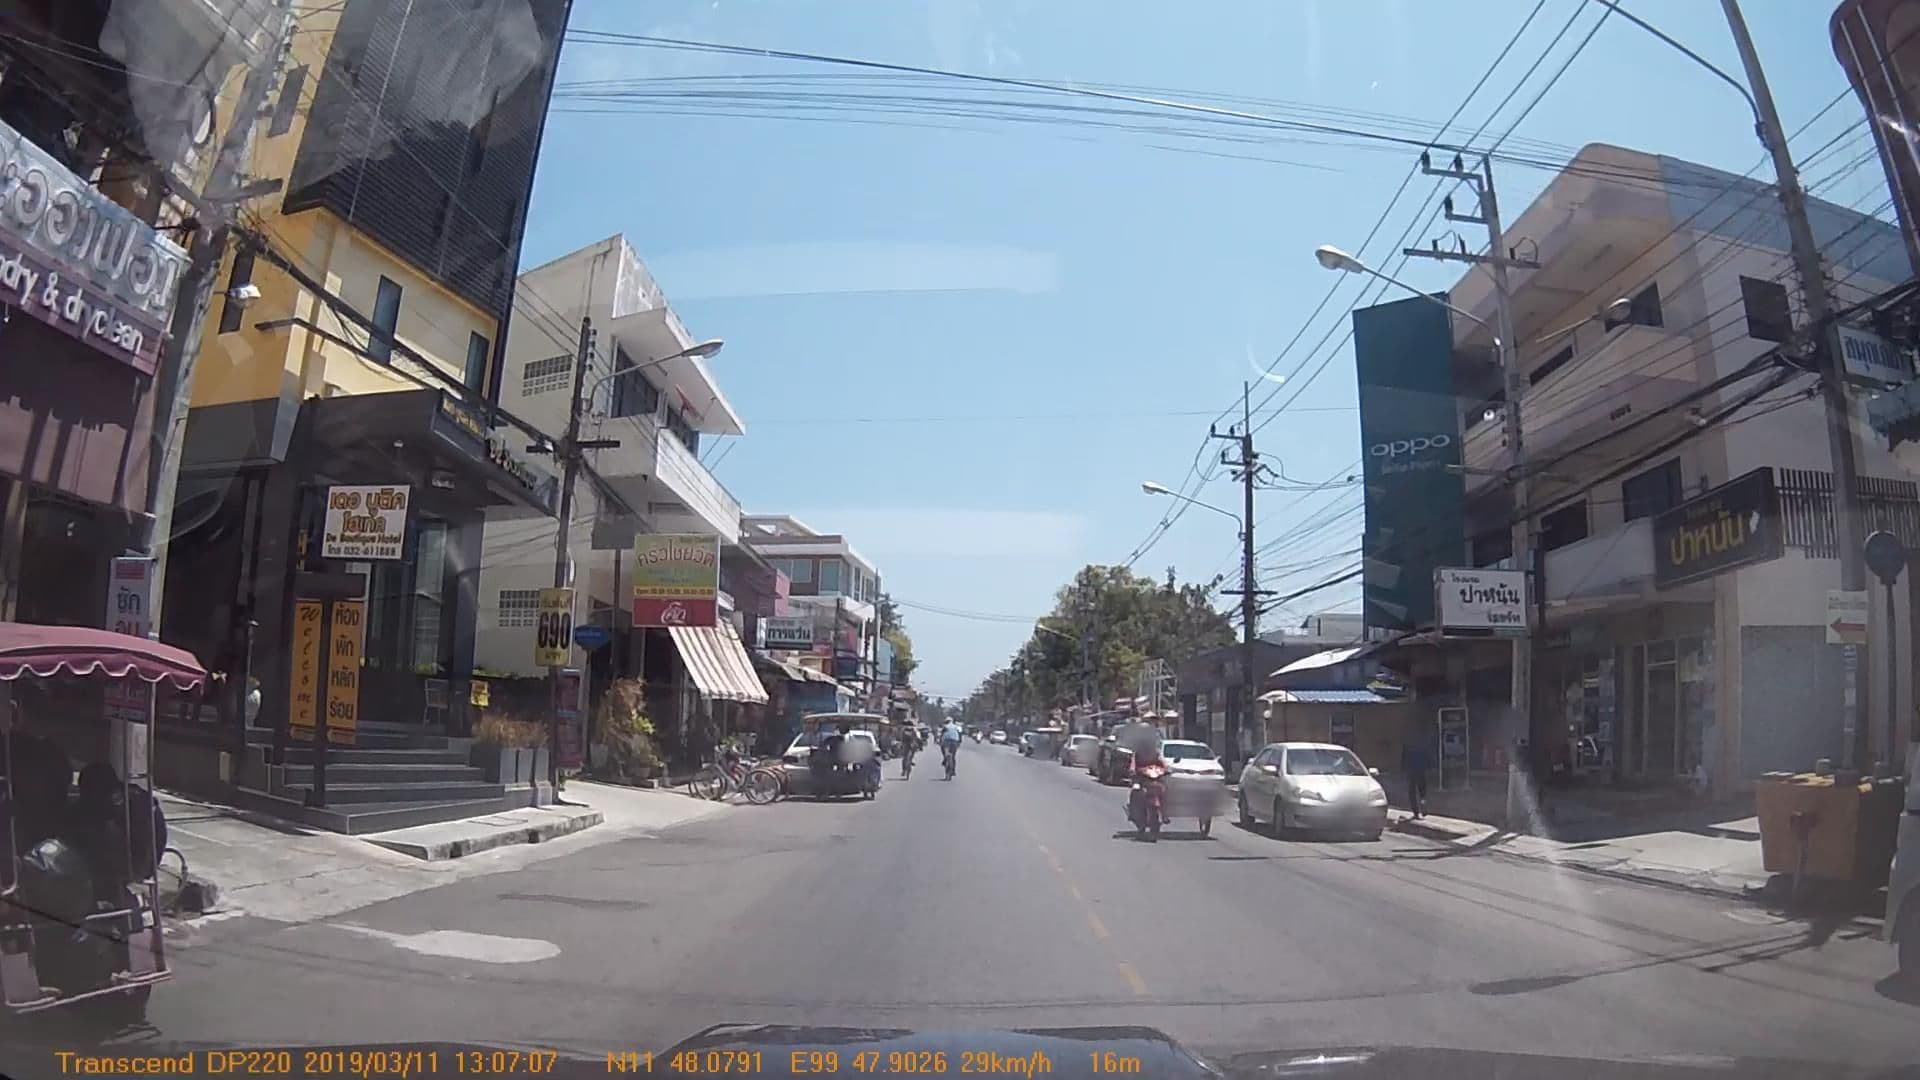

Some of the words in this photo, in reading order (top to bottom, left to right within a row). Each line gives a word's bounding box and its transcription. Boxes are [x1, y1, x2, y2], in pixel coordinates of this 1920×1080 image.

[42, 272, 59, 310] &
[65, 290, 143, 354] dryclean
[537, 612, 571, 649] 690
